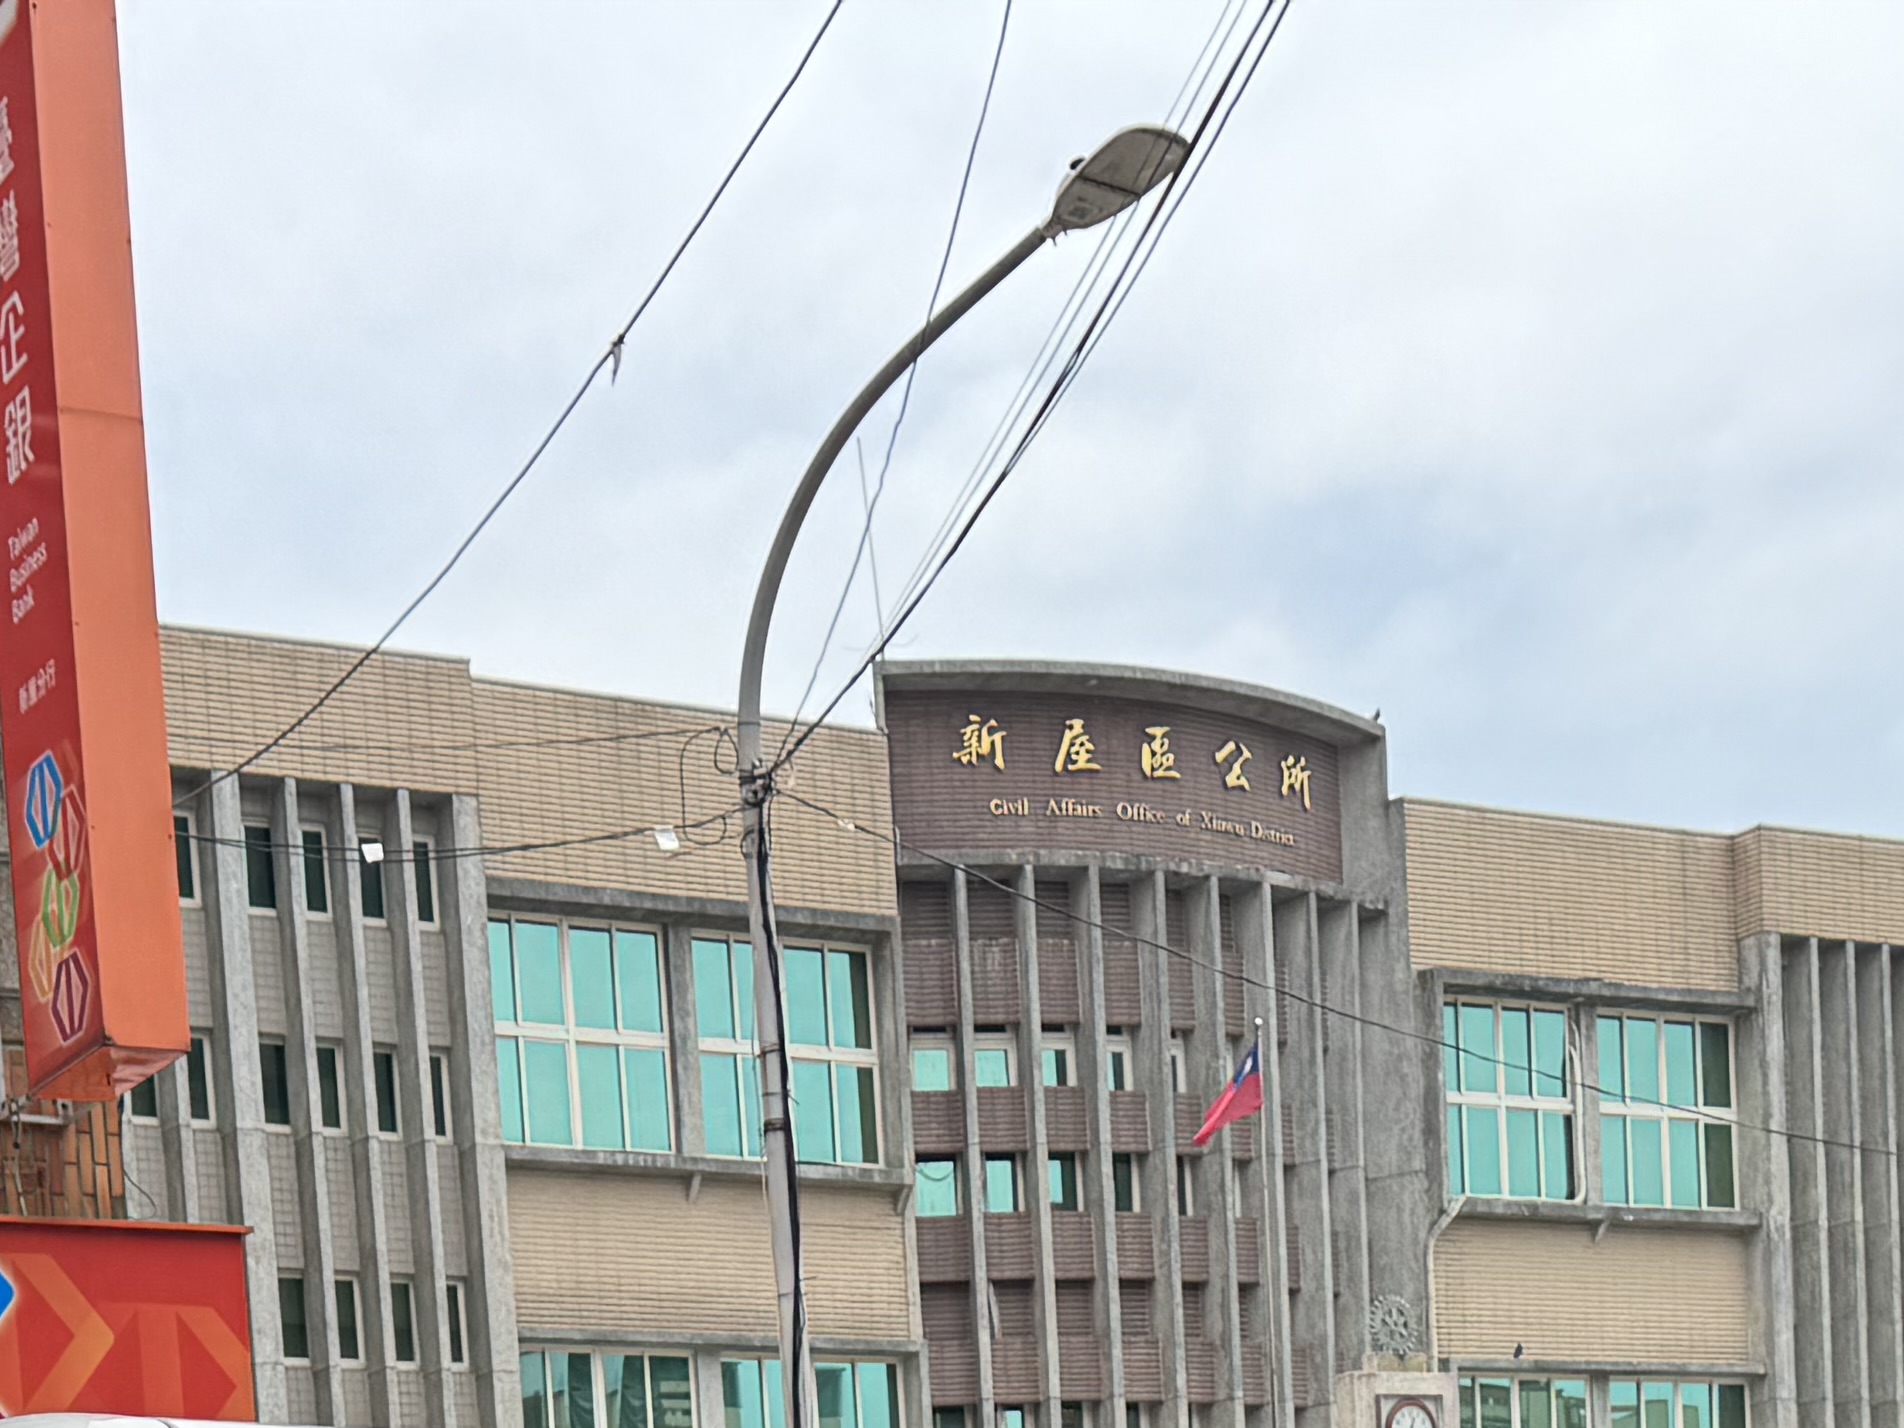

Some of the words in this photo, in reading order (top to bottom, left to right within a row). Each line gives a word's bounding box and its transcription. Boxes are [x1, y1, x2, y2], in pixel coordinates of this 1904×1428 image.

[952, 714, 1312, 811] 新屋區公所
[989, 798, 1029, 816] Civil
[1046, 798, 1102, 818] Affairs
[1116, 802, 1166, 824] Office
[1176, 808, 1191, 826] of
